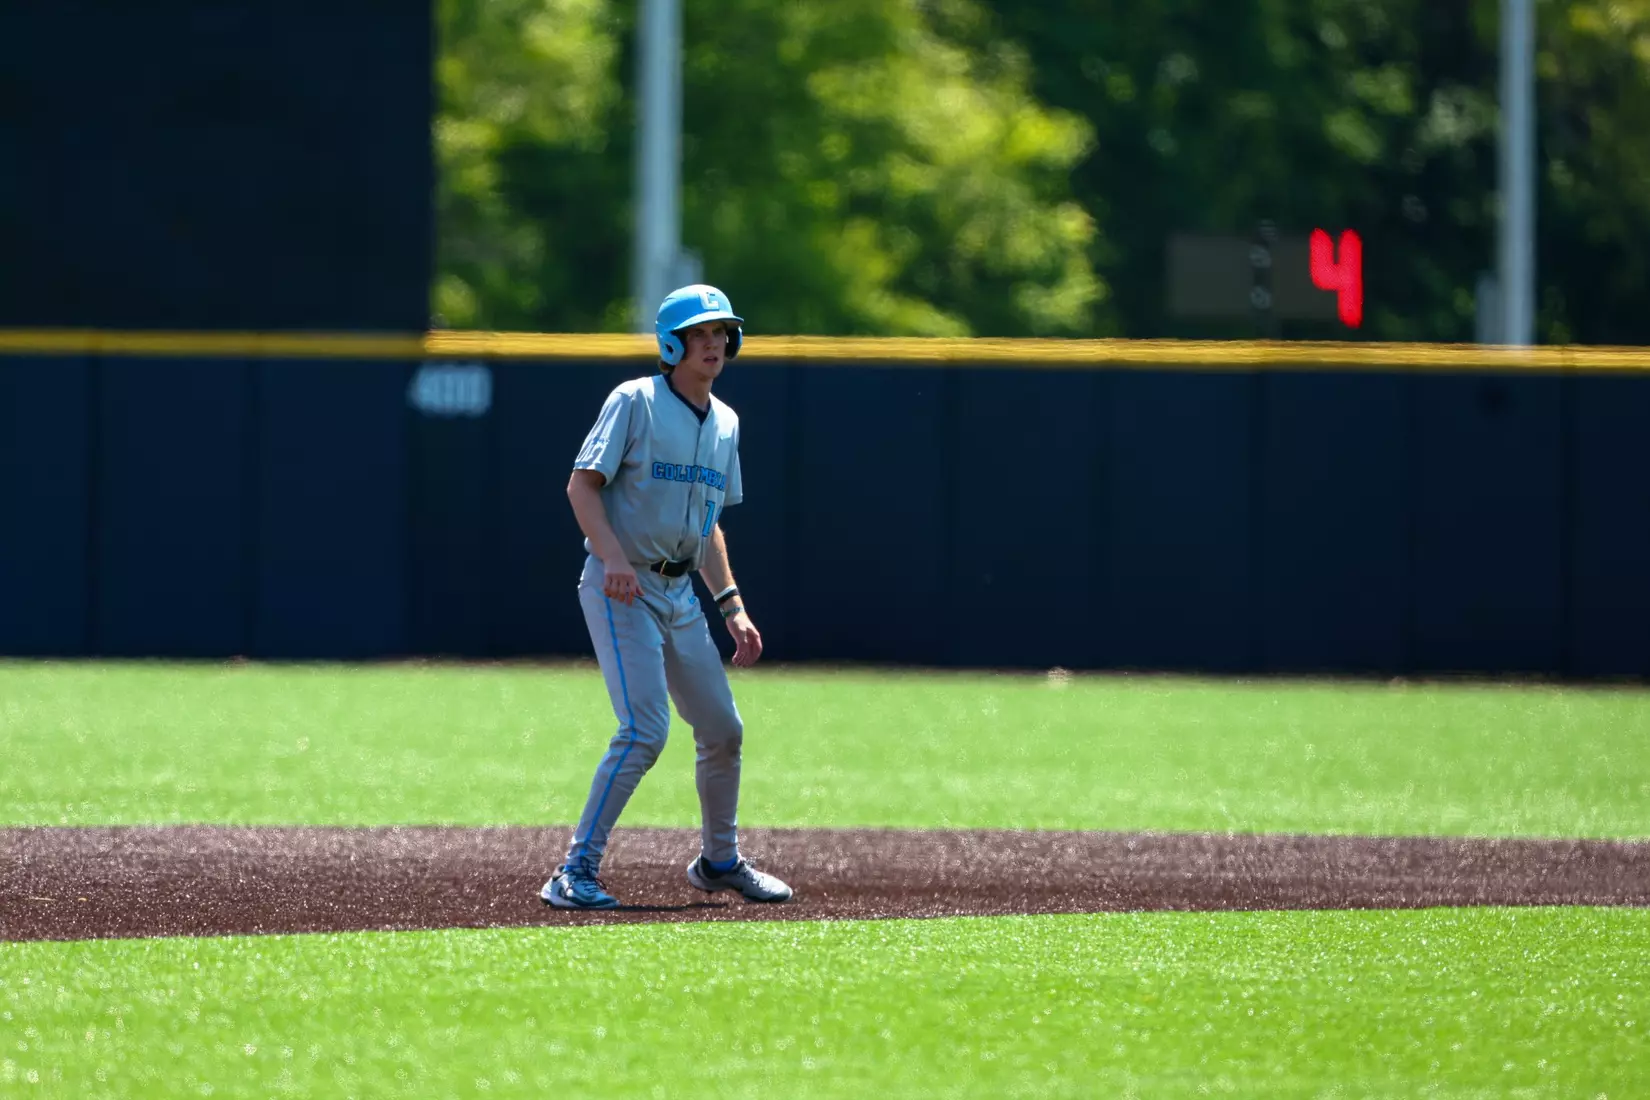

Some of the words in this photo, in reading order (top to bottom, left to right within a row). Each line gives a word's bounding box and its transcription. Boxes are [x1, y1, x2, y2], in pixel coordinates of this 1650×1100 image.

[1309, 228, 1363, 328] 4
[699, 290, 719, 310] C
[652, 461, 727, 492] COLUMBIA
